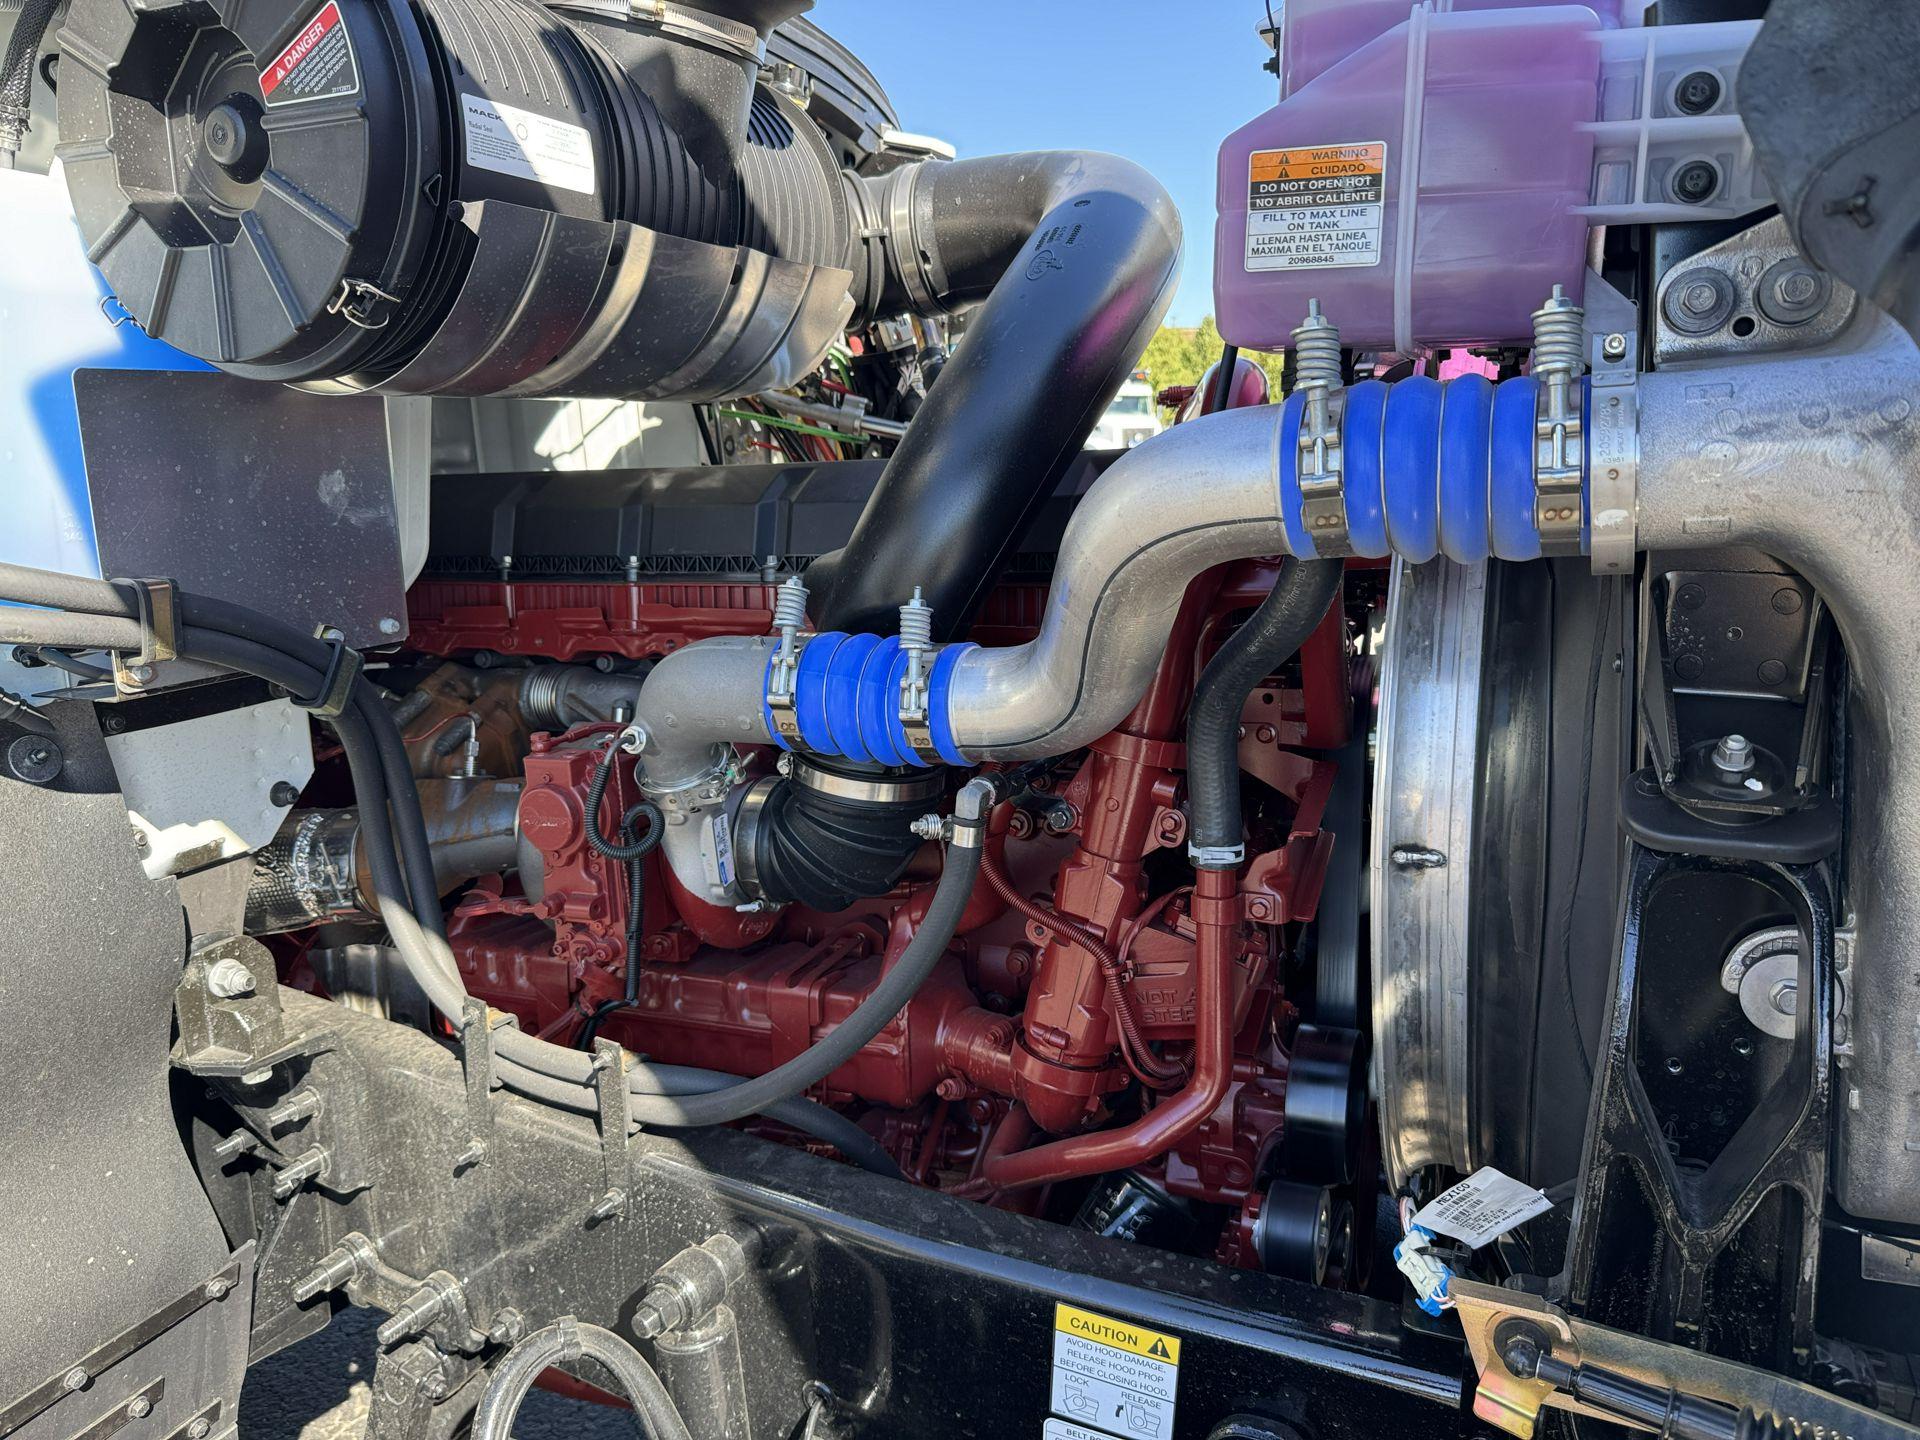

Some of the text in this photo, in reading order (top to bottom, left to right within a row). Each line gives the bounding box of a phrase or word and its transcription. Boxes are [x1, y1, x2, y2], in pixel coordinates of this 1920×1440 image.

[284, 22, 324, 69] DANGER
[324, 39, 345, 62] RESULTING
[284, 22, 341, 86] DO NOT USE ETHER WHICH CAN
[292, 30, 343, 86] CAUSE ENGINE DAMAGE OR
[309, 69, 326, 89] SERIOUS
[326, 48, 347, 72] PERSONAL
[314, 78, 328, 93] INJURY
[327, 70, 334, 79] OR
[468, 107, 503, 121] MACK
[1312, 149, 1368, 160] WARNING
[1311, 163, 1366, 175] CUIDADO
[1260, 176, 1372, 192] DO NOT OPEN HOT
[1256, 191, 1376, 207] NO ABRIR CALIENTE
[1262, 208, 1367, 222] FILL TO MAX LINE
[1287, 220, 1340, 231] ON TANK
[1256, 232, 1367, 245] LLENAR HASTA LINEA
[1251, 242, 1371, 256] MAXIMA EN EL TANQUE
[1288, 255, 1334, 265] 20968845
[1136, 990, 1177, 1005] NOT
[1143, 1007, 1196, 1022] STEP
[1436, 1182, 1471, 1206] MEXICO
[1070, 1317, 1138, 1347] CAUTION
[1066, 1337, 1093, 1352] AVOID
[1095, 1345, 1122, 1359] HOOD
[1068, 1348, 1164, 1383] RELEASE HOOD PROP
[1060, 1357, 1169, 1398] BEFORE CLOSING HOOD.
[1065, 1373, 1089, 1386] LOCK
[1121, 1392, 1162, 1409] RELEASE
[1066, 1428, 1087, 1440] BELT
